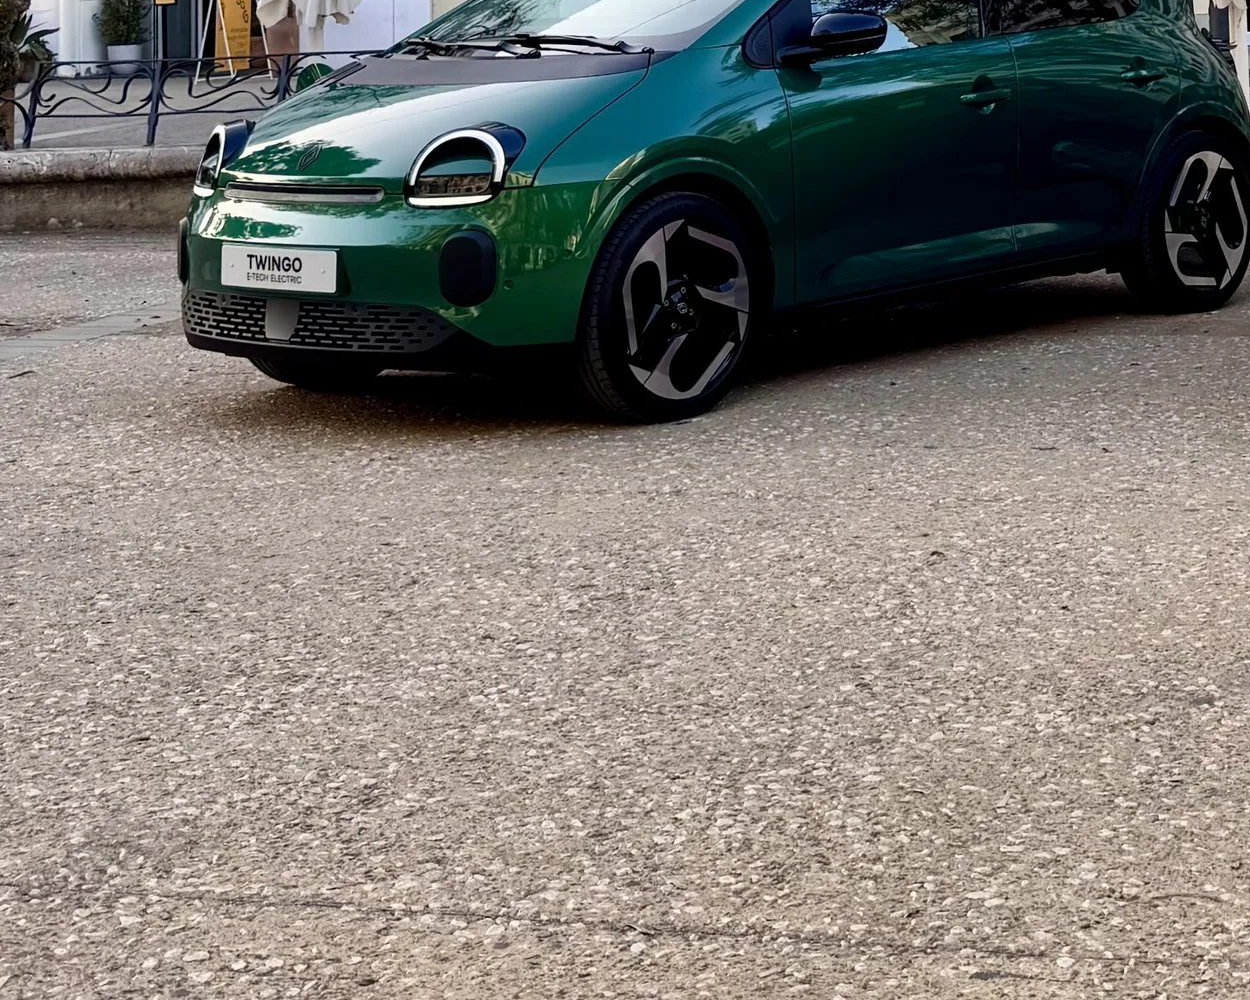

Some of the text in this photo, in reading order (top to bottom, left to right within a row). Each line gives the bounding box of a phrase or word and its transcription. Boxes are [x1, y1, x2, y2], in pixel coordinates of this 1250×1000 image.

[246, 254, 303, 273] TWINGO
[246, 272, 303, 284] E-TECH ELECTRIC
